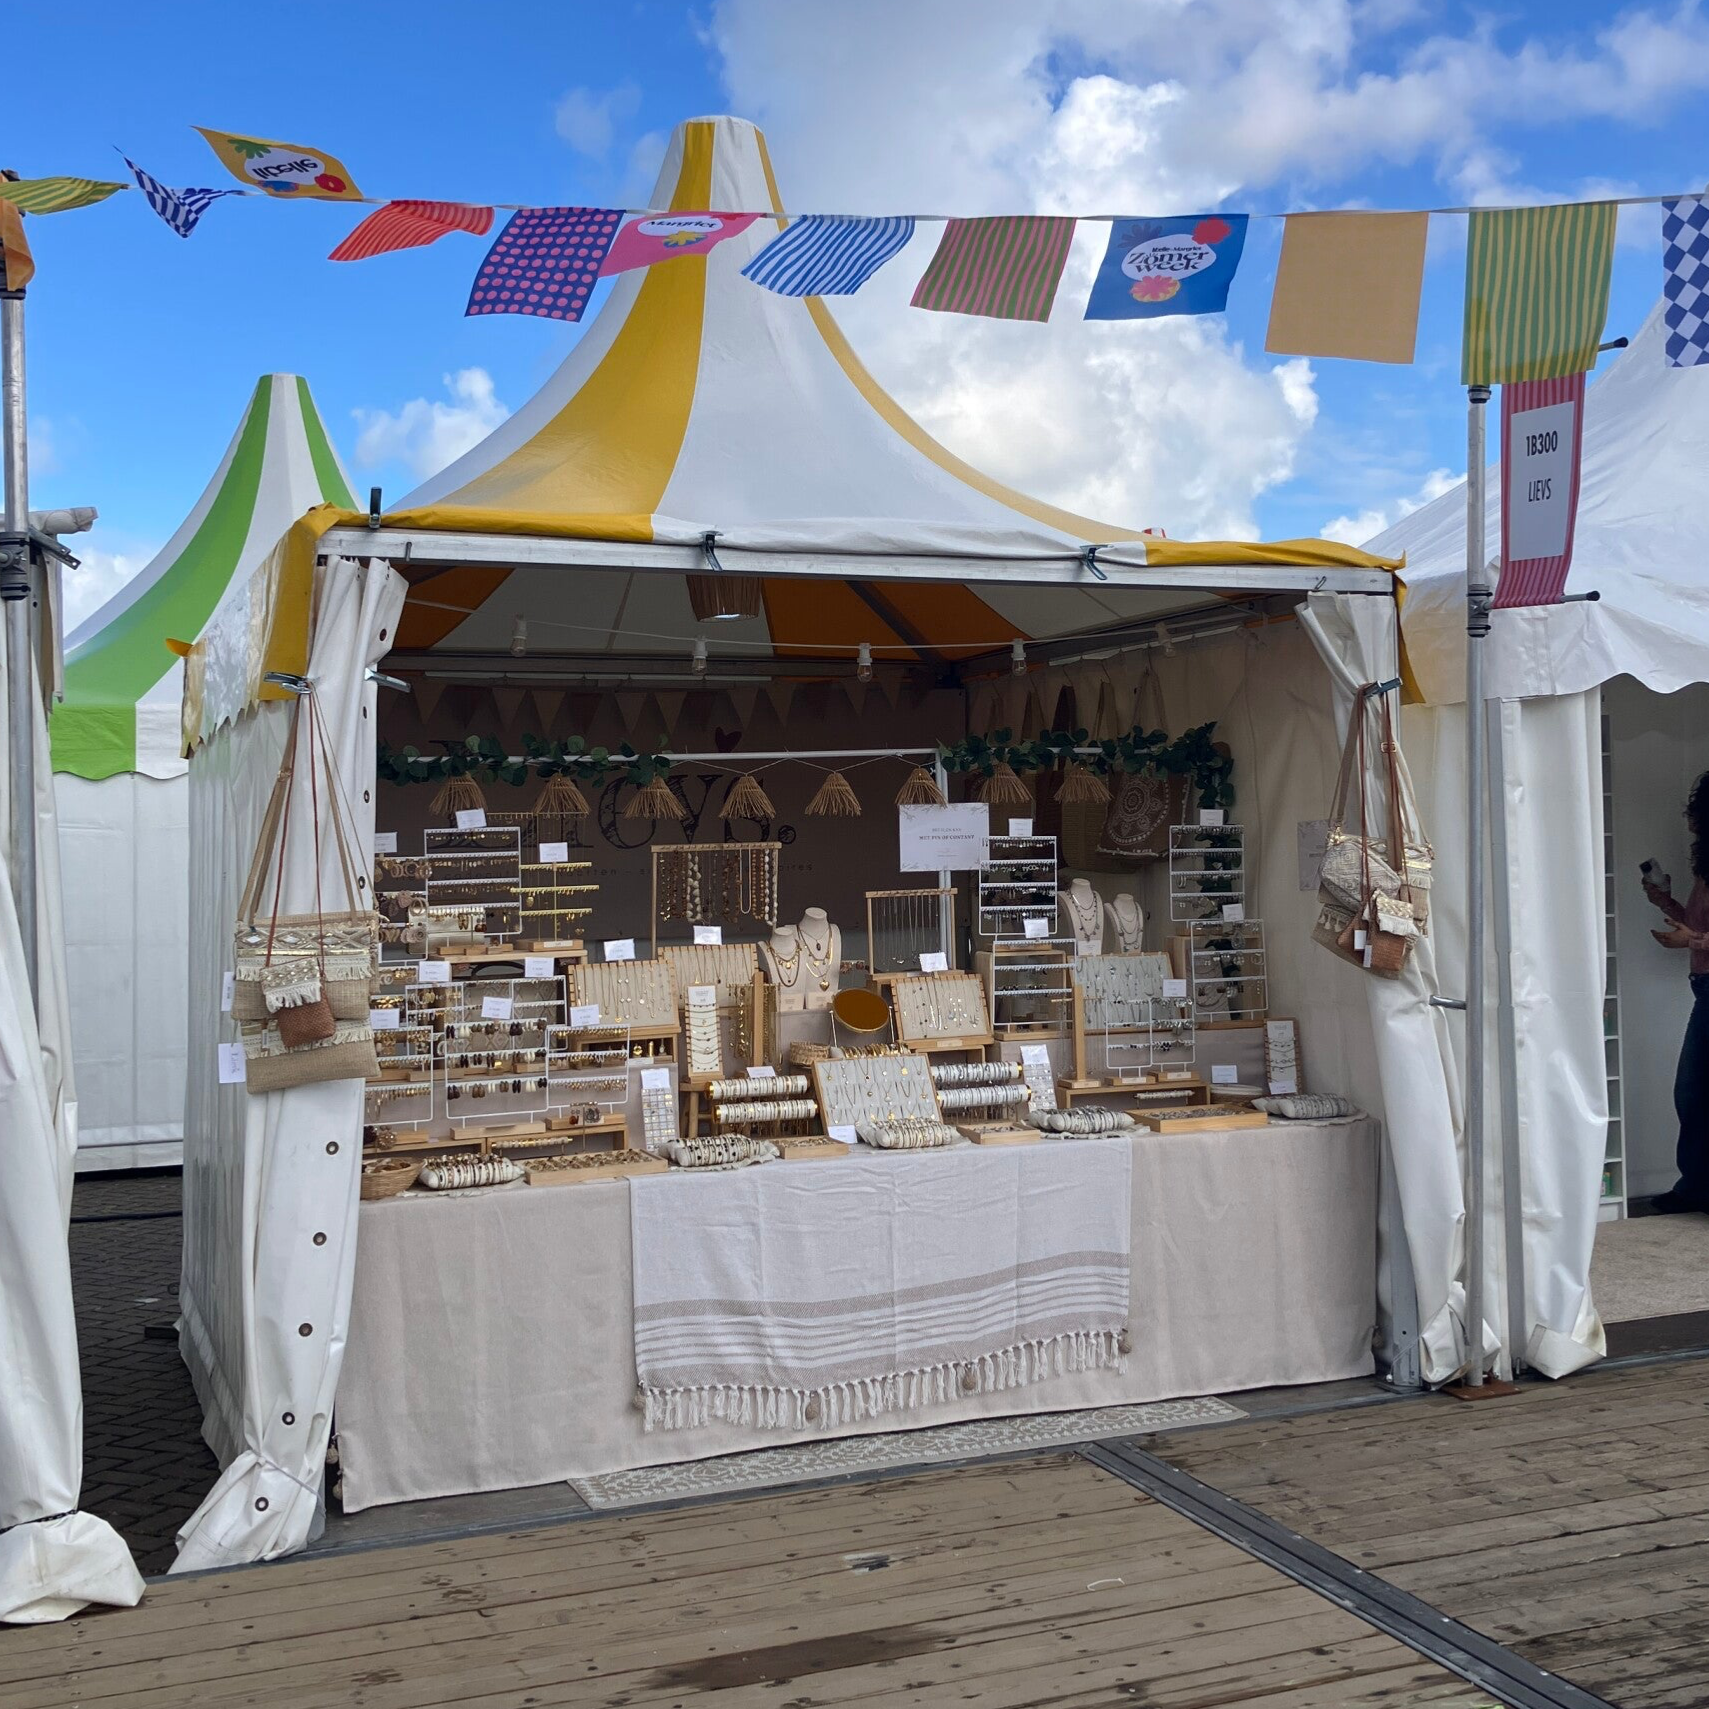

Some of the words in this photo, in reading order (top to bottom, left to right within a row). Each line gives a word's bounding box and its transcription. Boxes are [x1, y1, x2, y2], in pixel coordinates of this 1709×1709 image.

[1128, 251, 1209, 265] Zomer
[1136, 259, 1199, 272] week
[1526, 431, 1558, 456] 1B300
[1528, 478, 1551, 502] LIEVS
